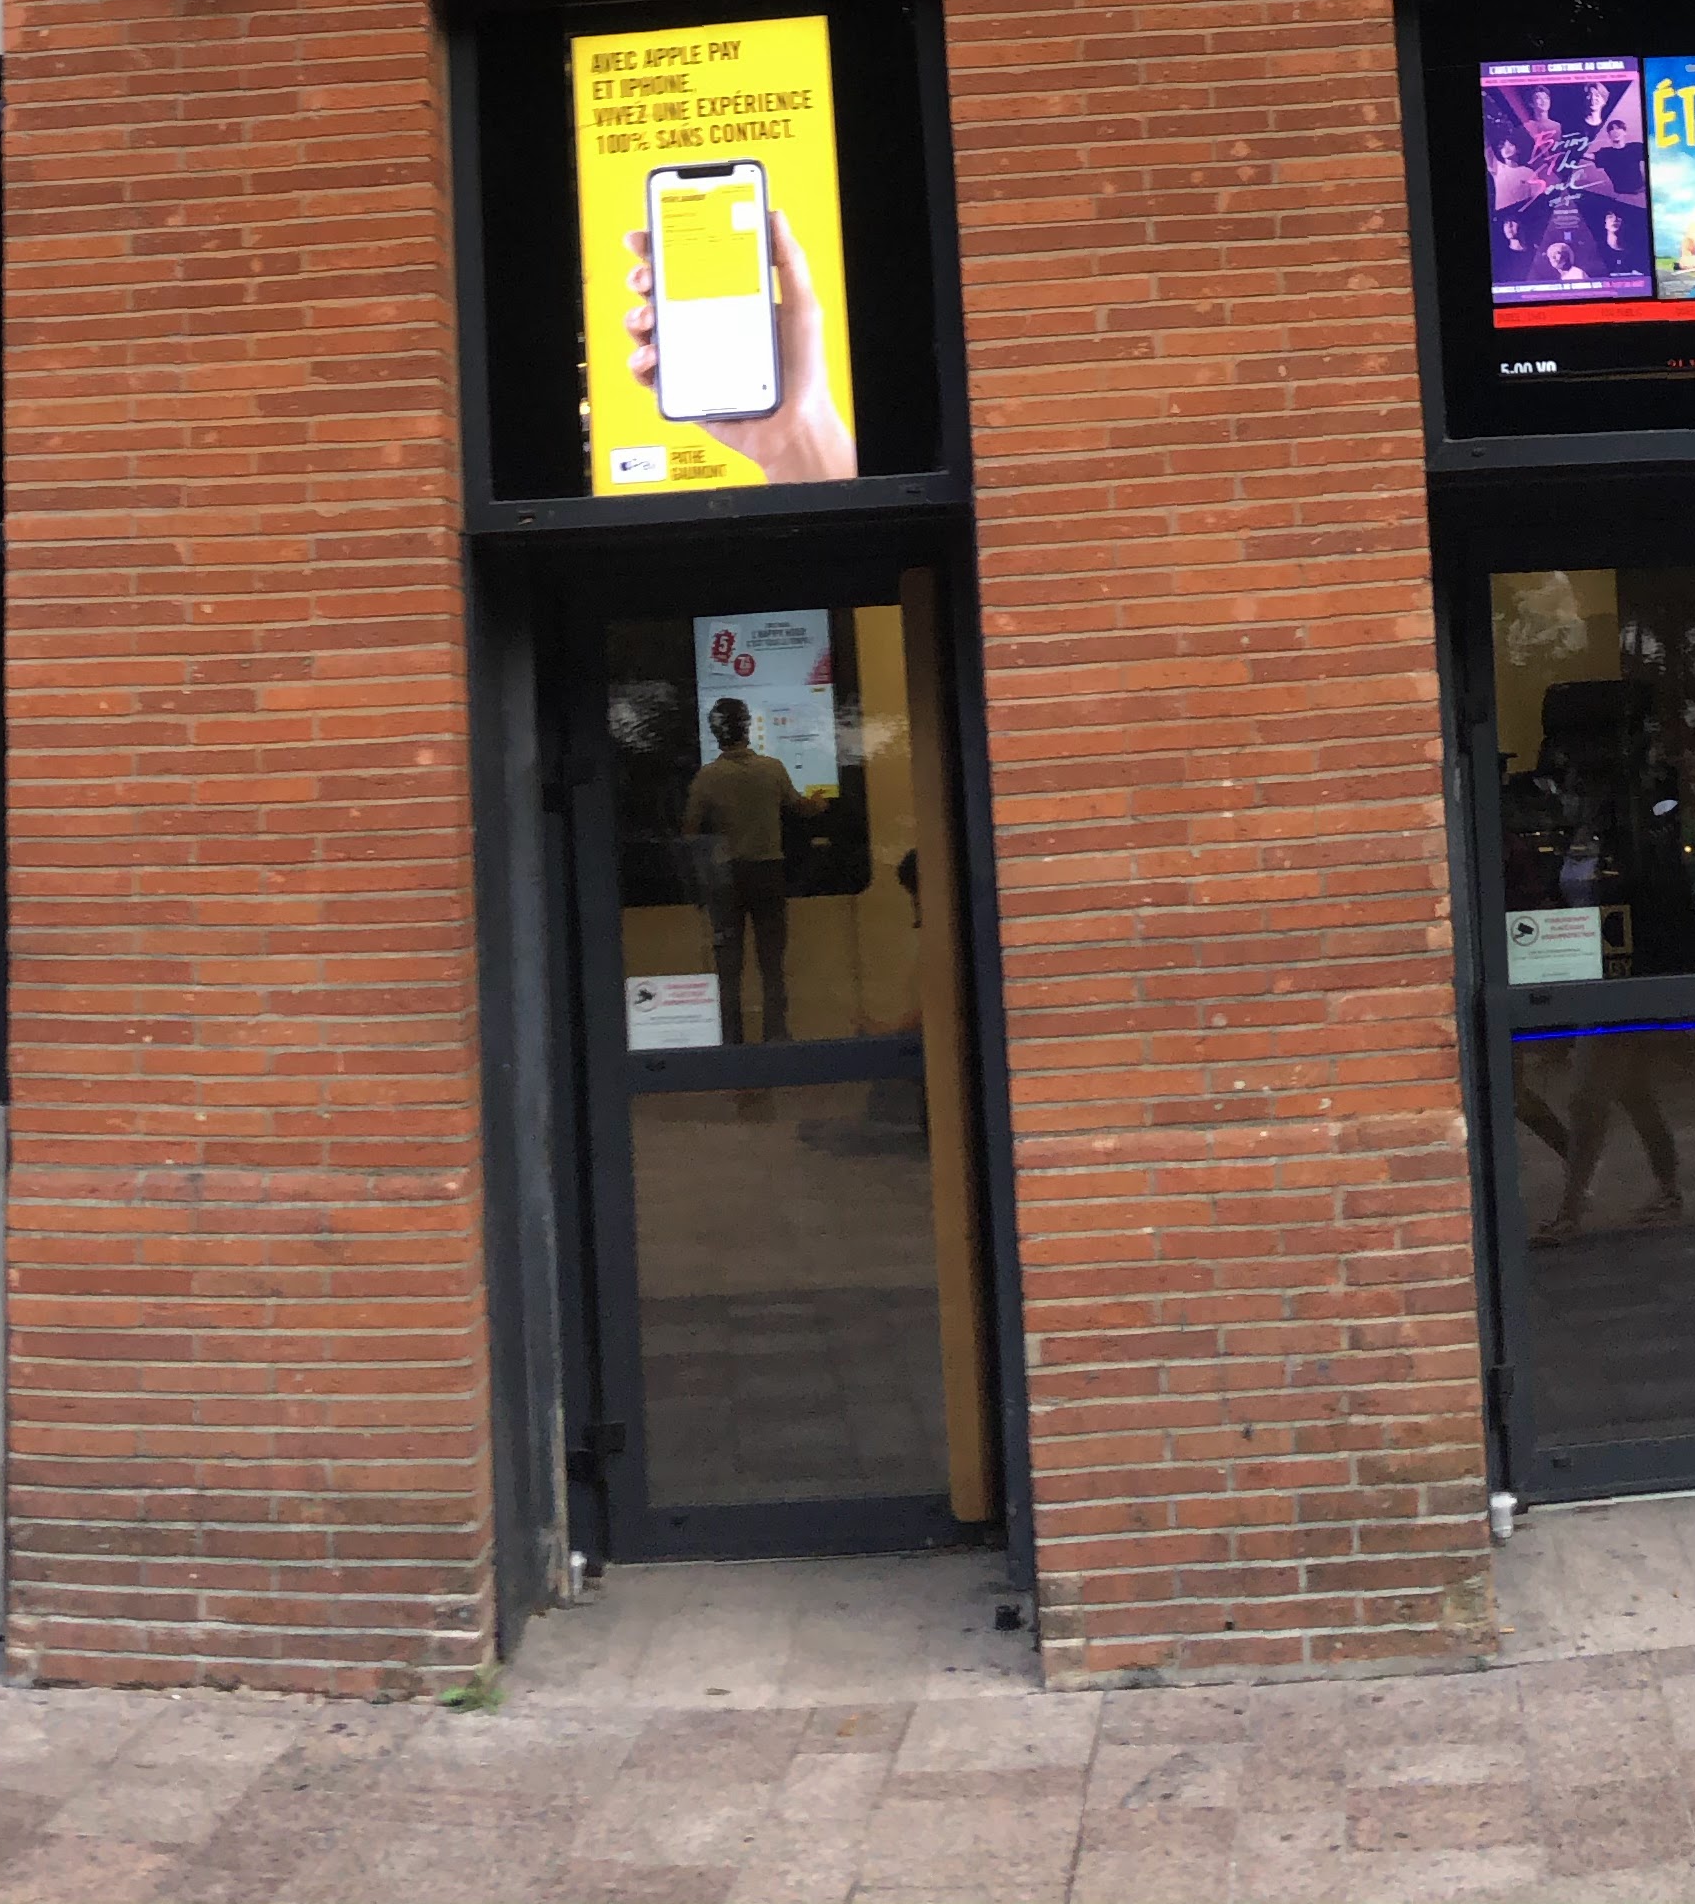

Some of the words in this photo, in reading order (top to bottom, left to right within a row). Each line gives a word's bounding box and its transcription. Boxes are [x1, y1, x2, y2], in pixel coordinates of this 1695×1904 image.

[591, 50, 638, 74] AVEC
[642, 44, 703, 69] APPLE
[707, 40, 741, 62] PAY
[592, 79, 615, 101] ET
[696, 90, 814, 118] EXPÉRIENCE
[655, 125, 705, 150] SANS
